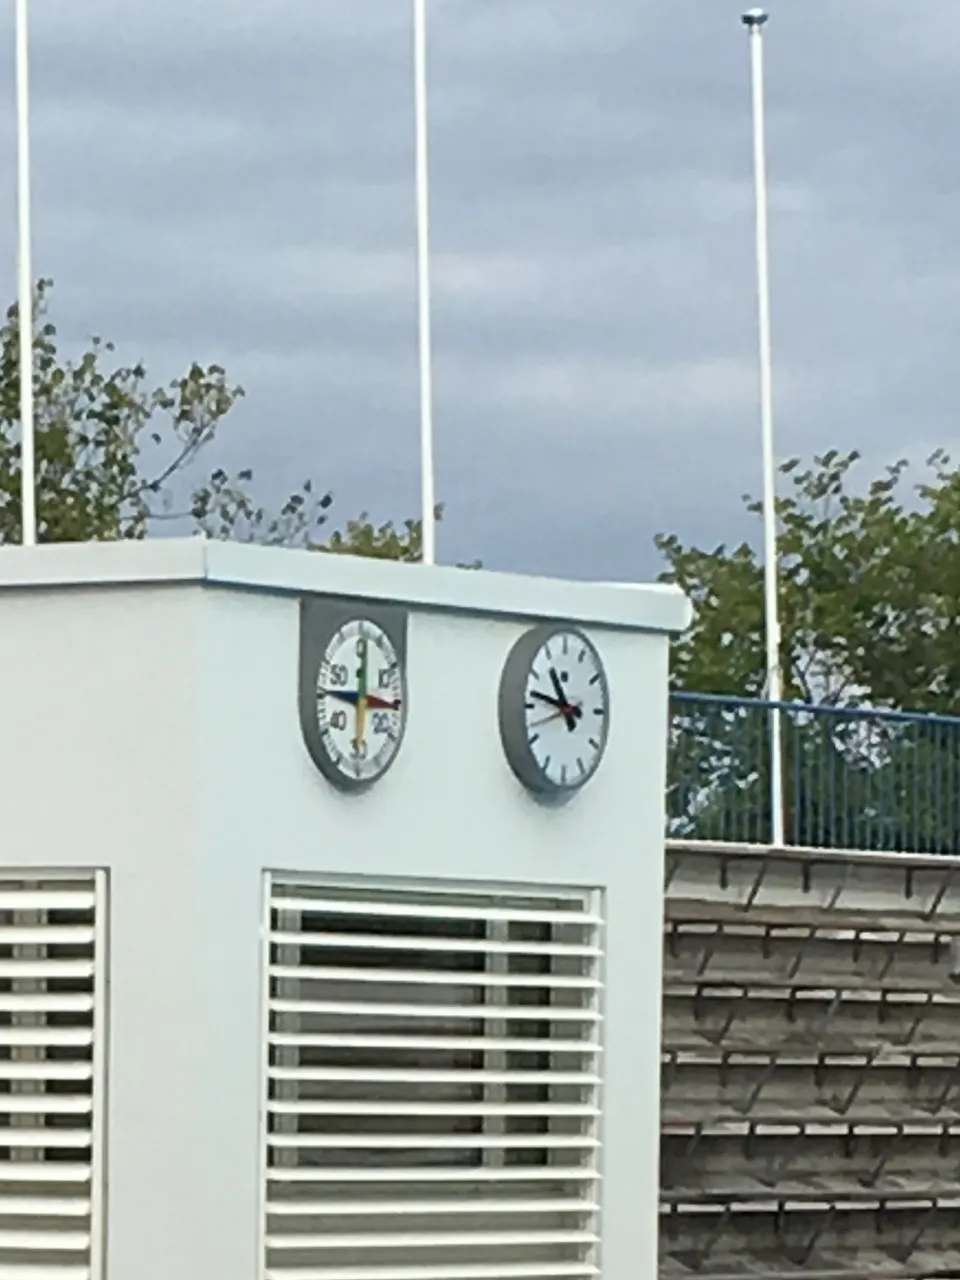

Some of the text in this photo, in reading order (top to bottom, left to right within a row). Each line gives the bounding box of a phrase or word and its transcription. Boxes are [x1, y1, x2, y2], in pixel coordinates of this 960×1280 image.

[330, 664, 348, 687] 50
[378, 669, 390, 689] 10
[330, 710, 347, 731] 40
[372, 712, 390, 734] 20
